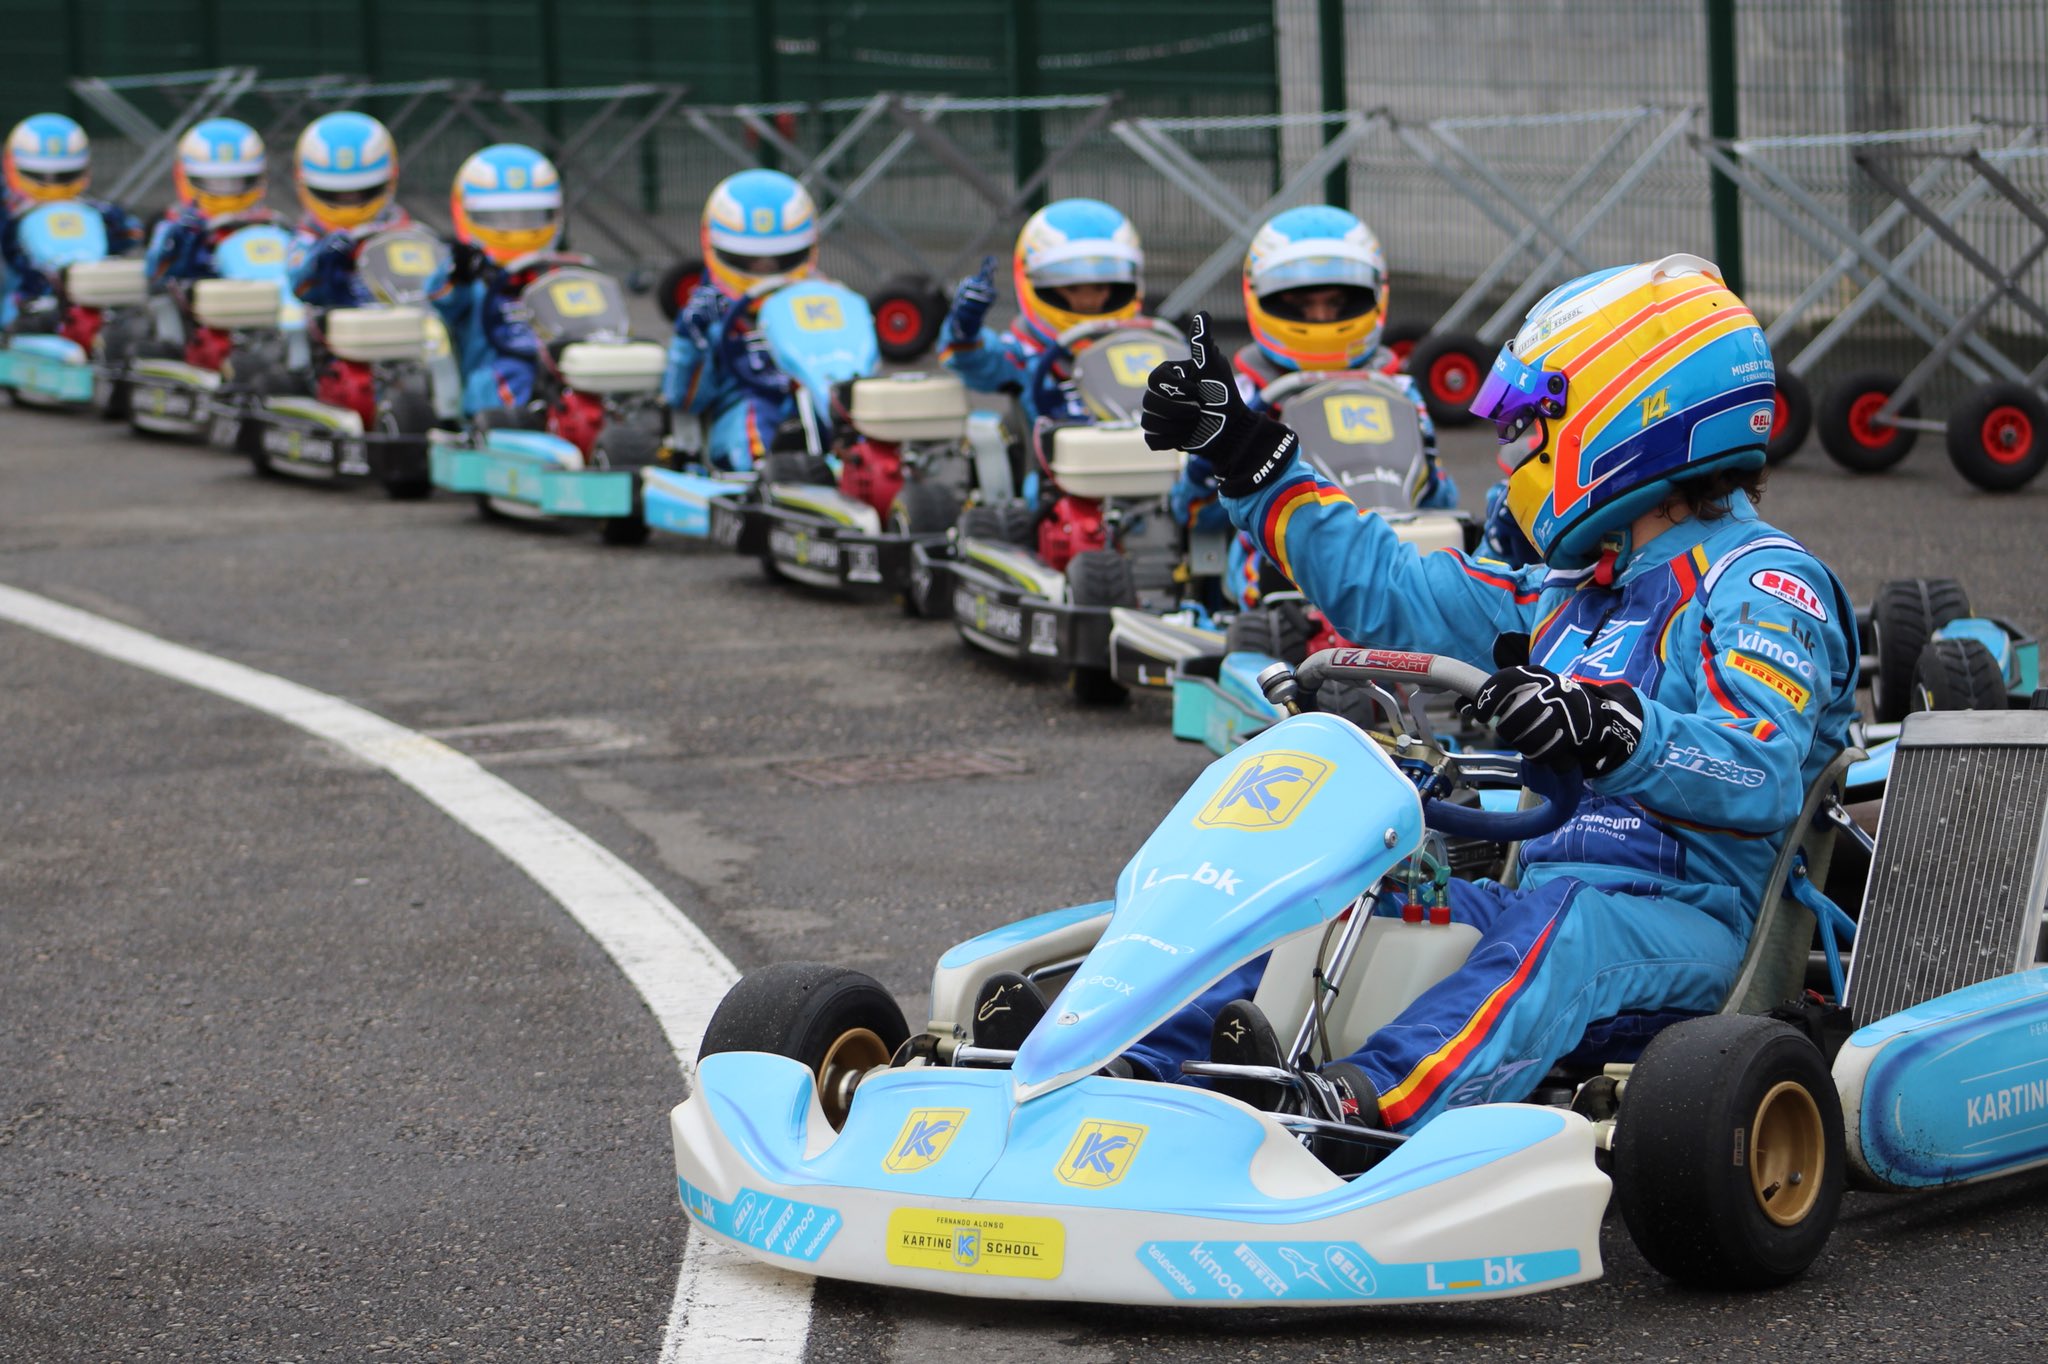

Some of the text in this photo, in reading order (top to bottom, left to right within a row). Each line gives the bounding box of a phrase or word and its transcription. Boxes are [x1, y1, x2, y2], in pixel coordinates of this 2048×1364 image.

[1731, 360, 1759, 376] MUSEO
[1759, 359, 1764, 369] Y
[1639, 387, 1671, 428] 14
[1753, 415, 1770, 426] BELL
[1252, 460, 1275, 484] ONE
[1762, 572, 1824, 618] BELL
[1774, 589, 1808, 611] HELMETS
[1370, 650, 1431, 661] ALONSO
[1386, 660, 1428, 671] KART
[1734, 655, 1804, 704] PIRELLI
[1580, 814, 1641, 830] CIRCUITO
[1584, 824, 1626, 841] ALONSO
[1967, 1078, 2048, 1129] KARTIN
[898, 1120, 951, 1158] K
[1072, 1132, 1129, 1173] K
[734, 1201, 753, 1231] BELL
[764, 1203, 795, 1251] PIRELLI
[783, 1207, 816, 1255] kimoa
[936, 1216, 1004, 1229] FERNANDO ALONSO
[903, 1234, 952, 1249] KARTING
[986, 1242, 1040, 1257] SCHOOL
[1148, 1244, 1197, 1296] telecable
[1189, 1241, 1244, 1299] kimoa
[1233, 1242, 1290, 1297] PIRELLI
[1330, 1251, 1369, 1293] BELL
